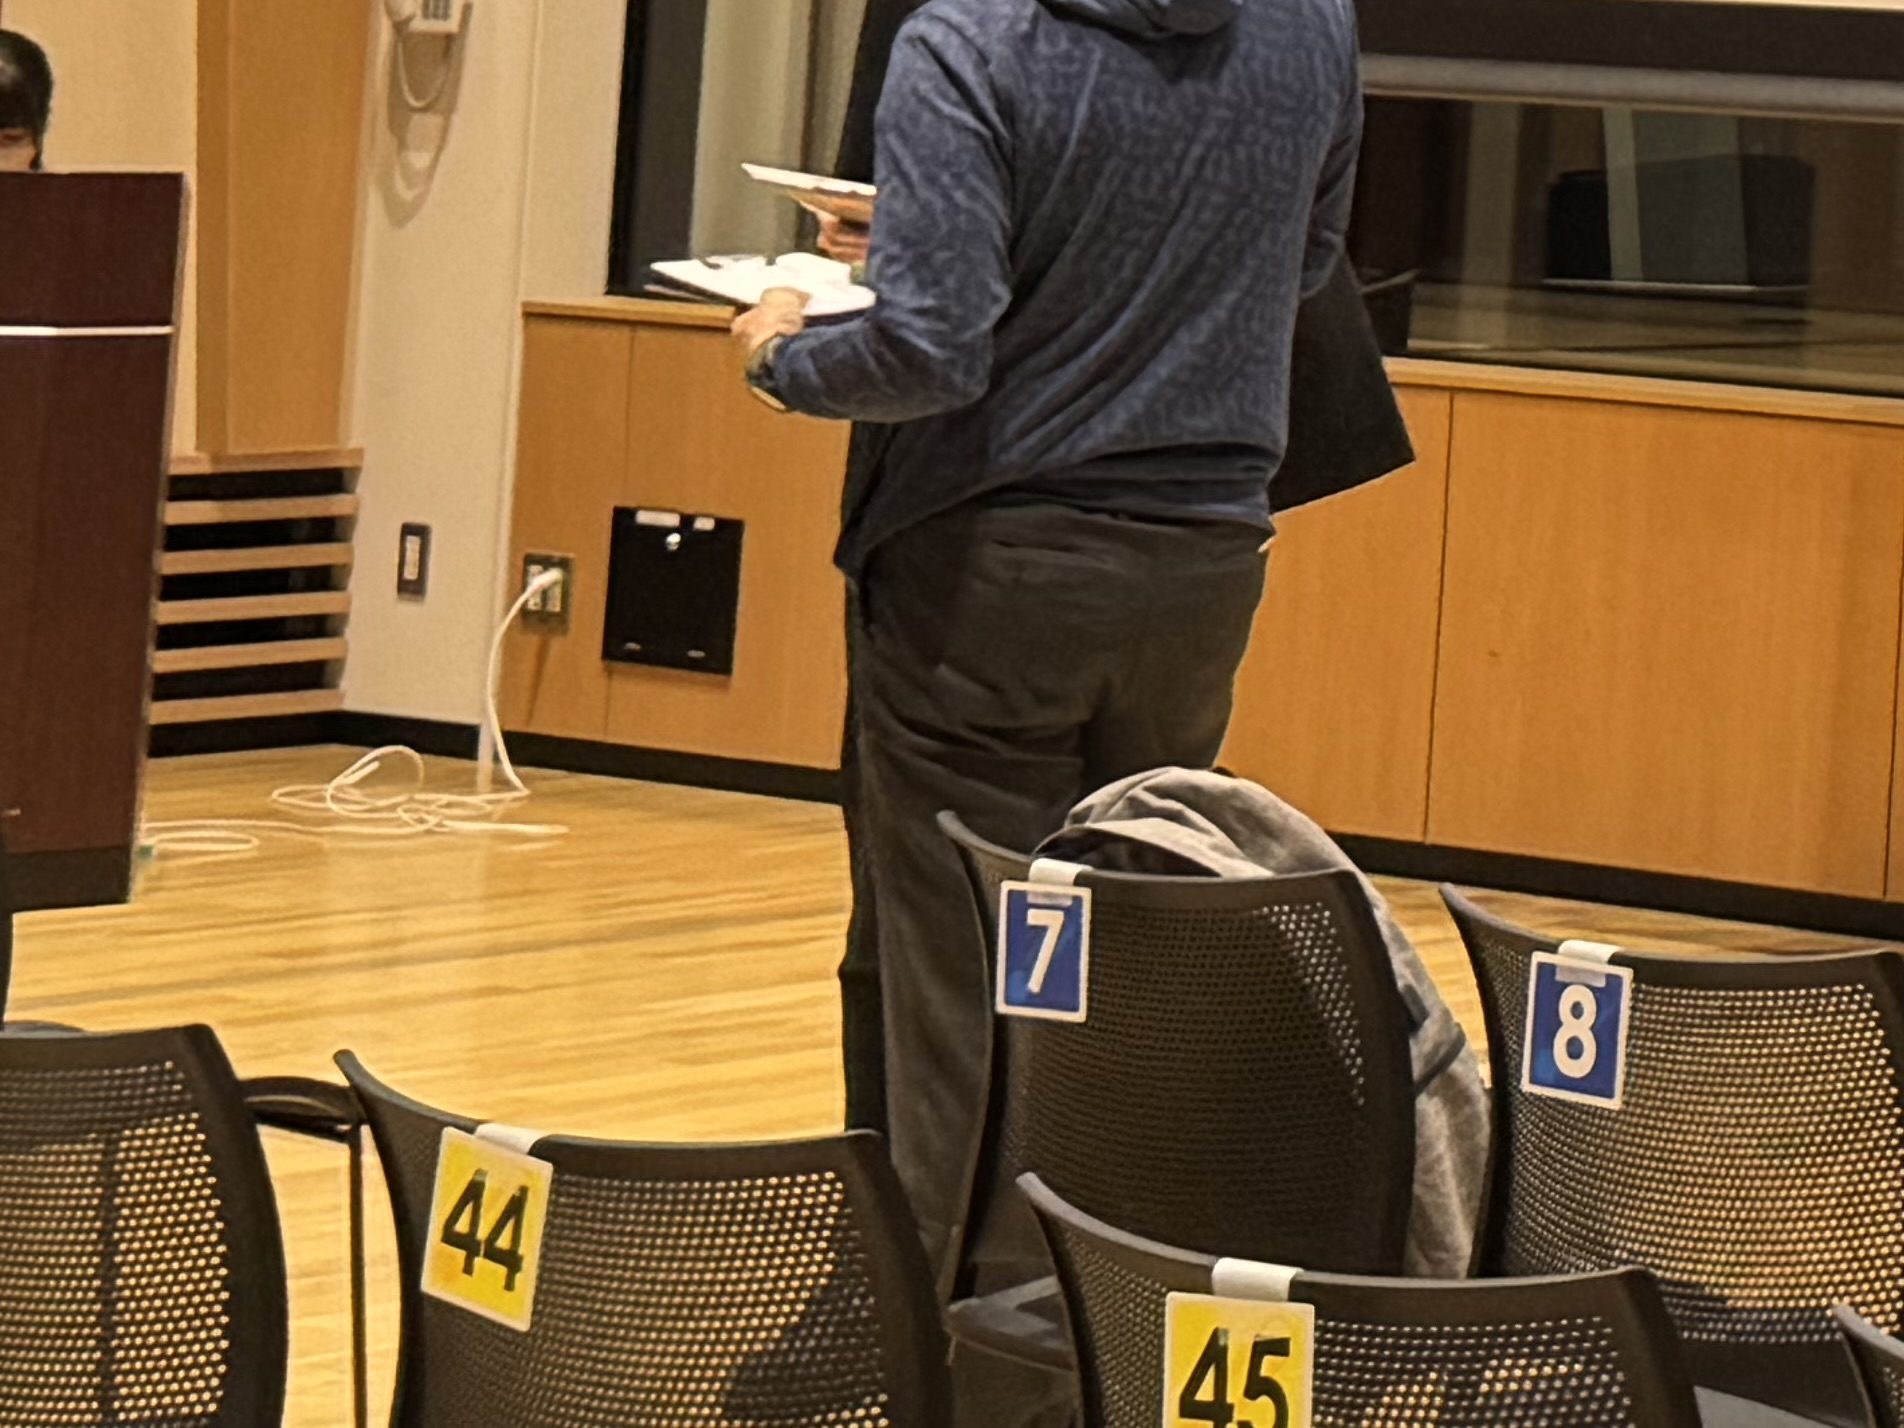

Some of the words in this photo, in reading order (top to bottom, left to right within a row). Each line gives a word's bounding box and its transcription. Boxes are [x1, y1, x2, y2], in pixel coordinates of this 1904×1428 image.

[1023, 907, 1066, 995] 7
[1552, 983, 1598, 1079] 8
[440, 1169, 529, 1292] 44
[1179, 1326, 1291, 1428] 45
